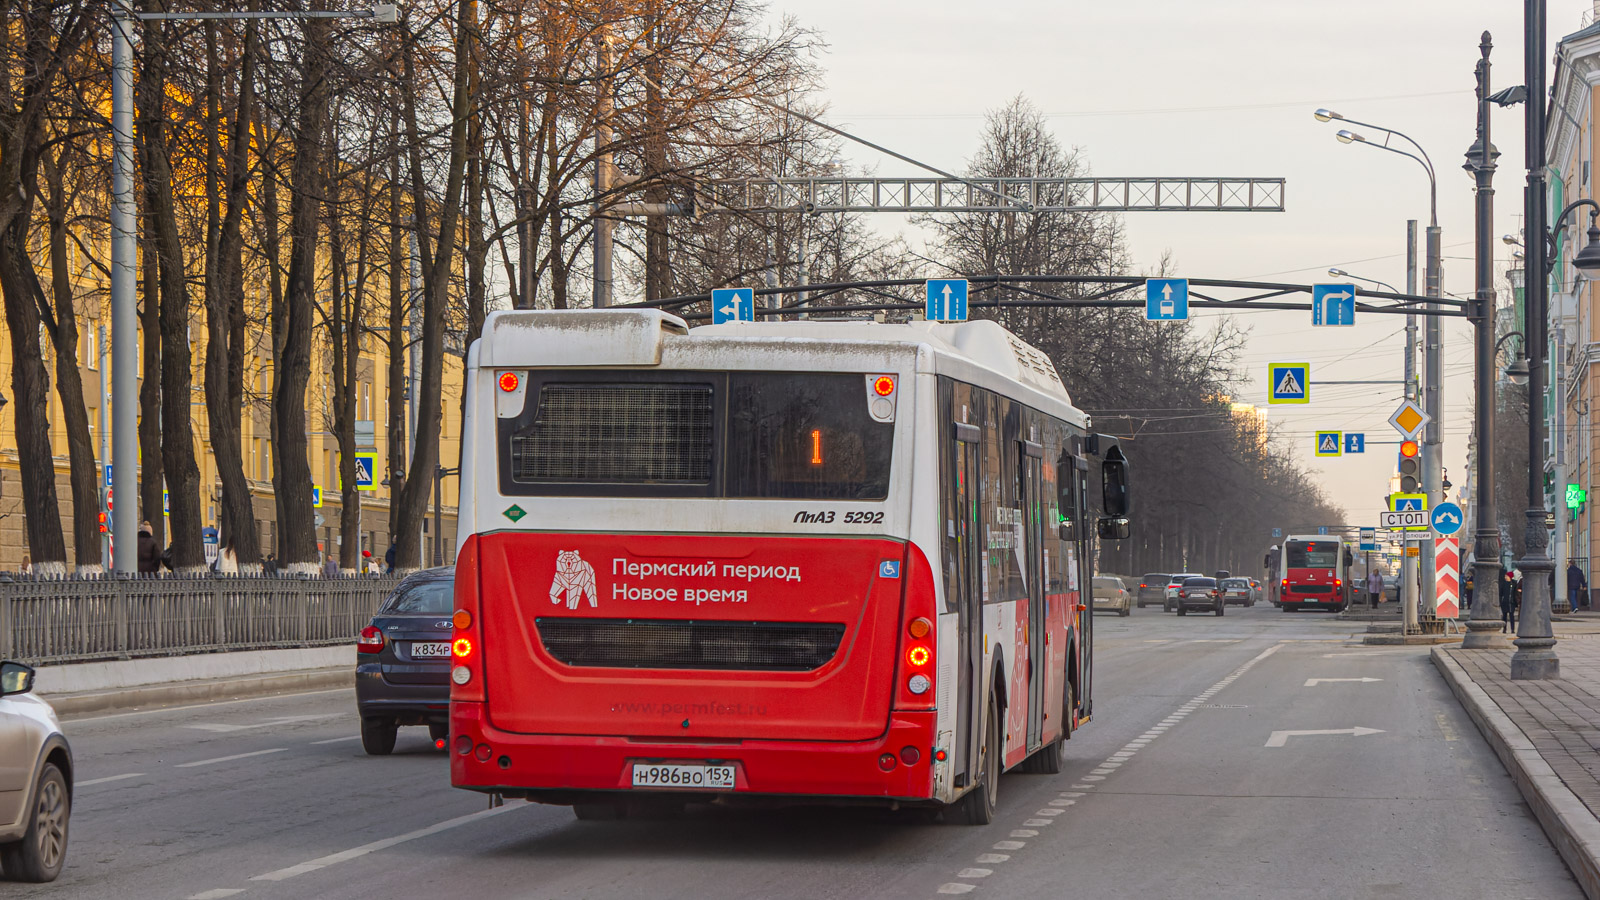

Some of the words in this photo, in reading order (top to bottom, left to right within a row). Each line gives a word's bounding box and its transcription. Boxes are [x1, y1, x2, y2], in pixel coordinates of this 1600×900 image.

[811, 430, 822, 464] 1
[843, 511, 885, 524] 5292
[1387, 513, 1423, 525] СТОП
[612, 557, 716, 580] Пермский
[723, 564, 801, 582] период
[612, 583, 678, 602] Новое
[684, 588, 748, 606] время
[706, 767, 730, 781] 159
